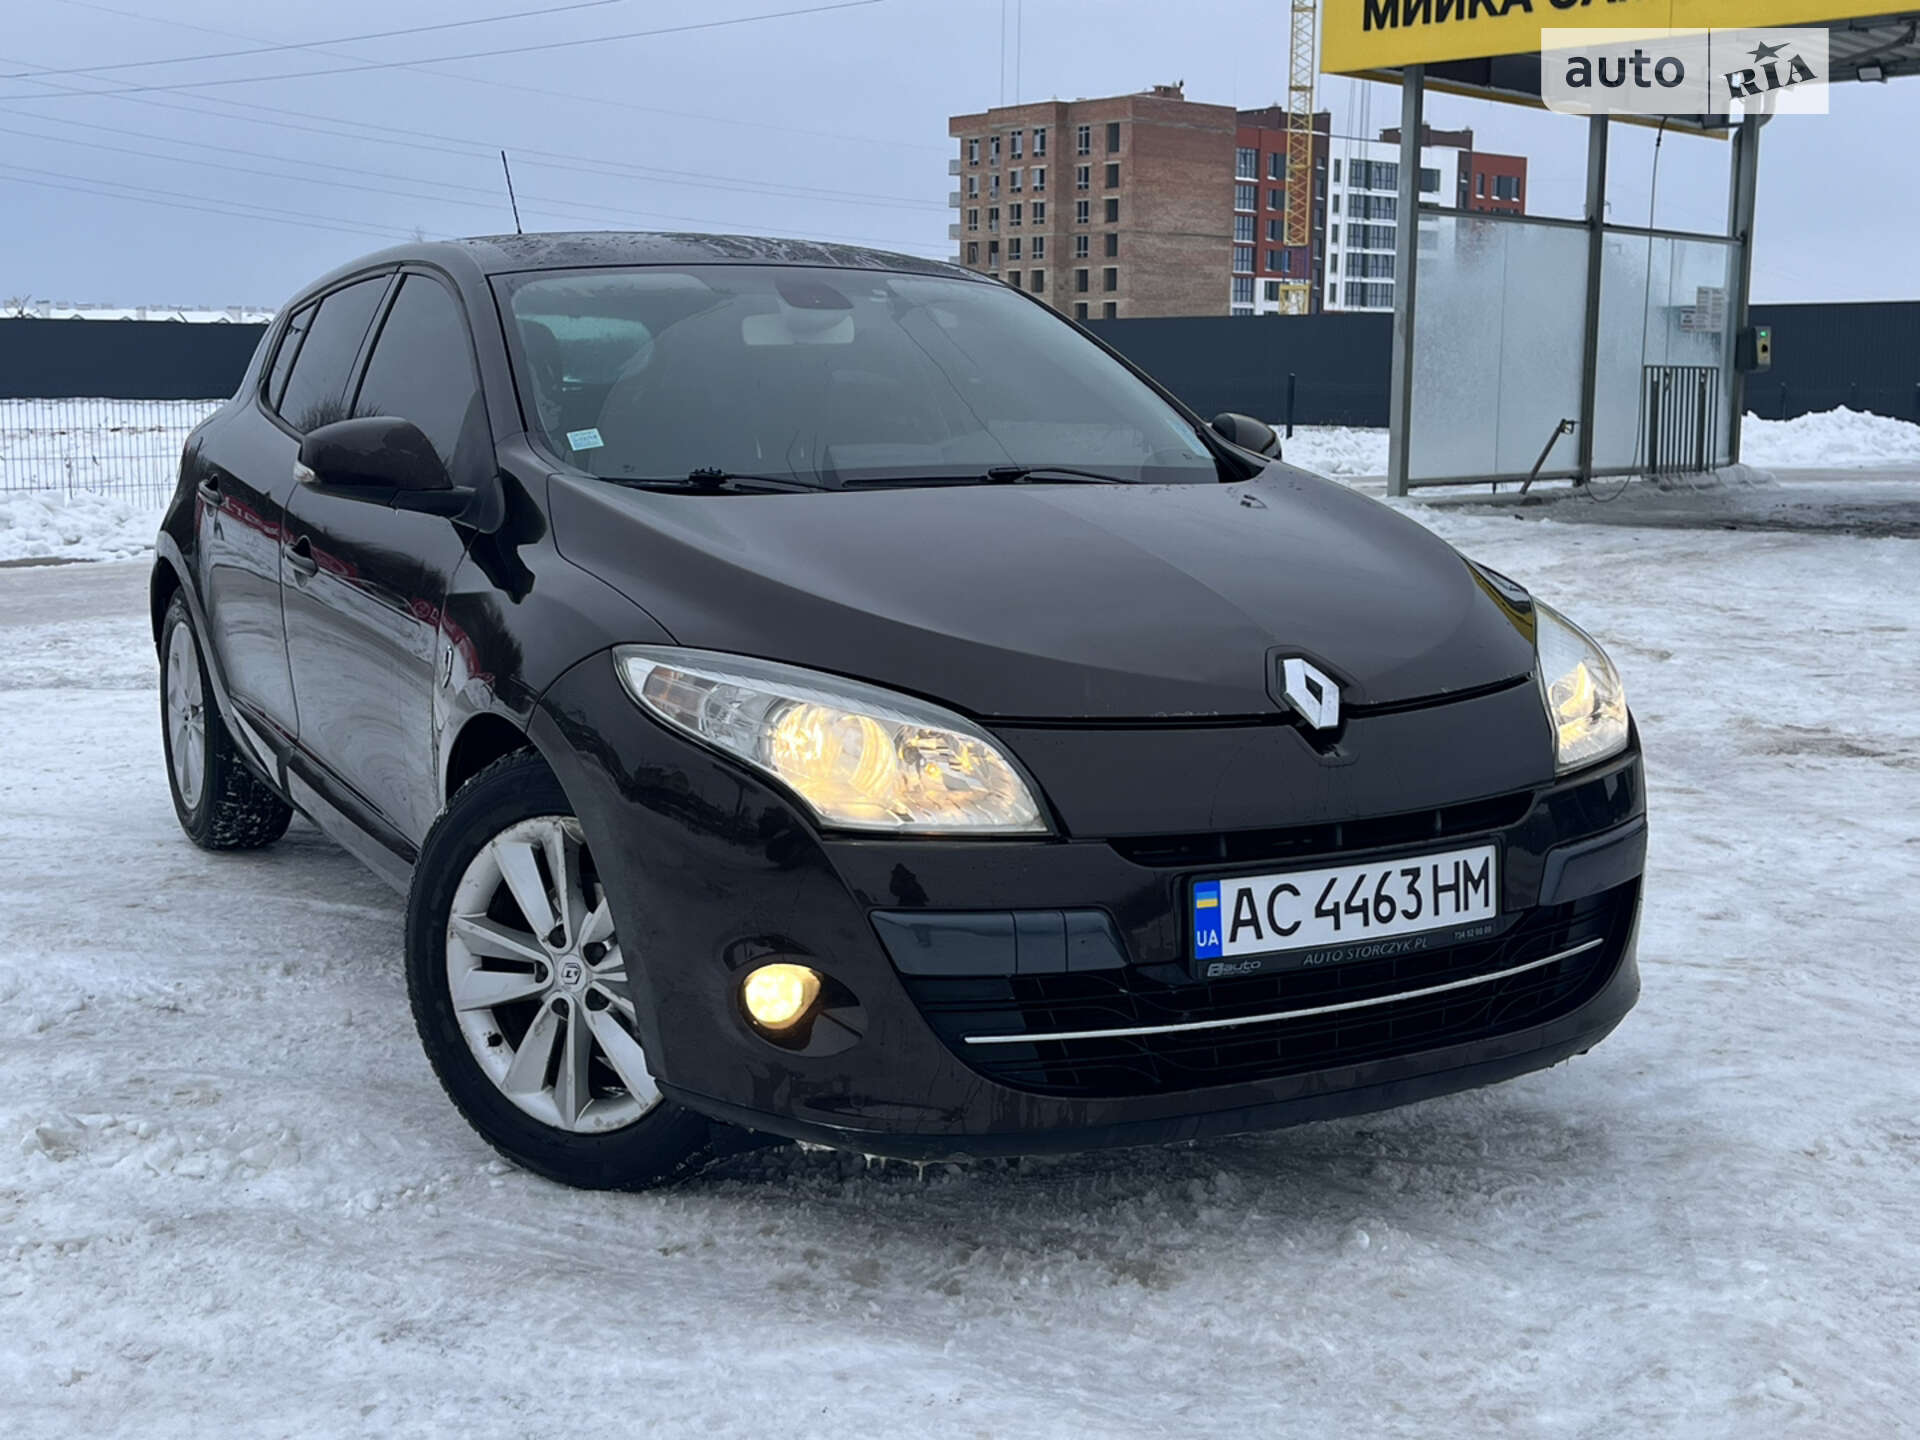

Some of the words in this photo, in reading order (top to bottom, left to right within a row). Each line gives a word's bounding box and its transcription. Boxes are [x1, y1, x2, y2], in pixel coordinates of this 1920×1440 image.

[1229, 883, 1302, 943] AC
[1314, 866, 1423, 931] 4463
[1432, 856, 1490, 917] HM
[1196, 929, 1219, 947] UA
[1303, 950, 1343, 966] AUTO
